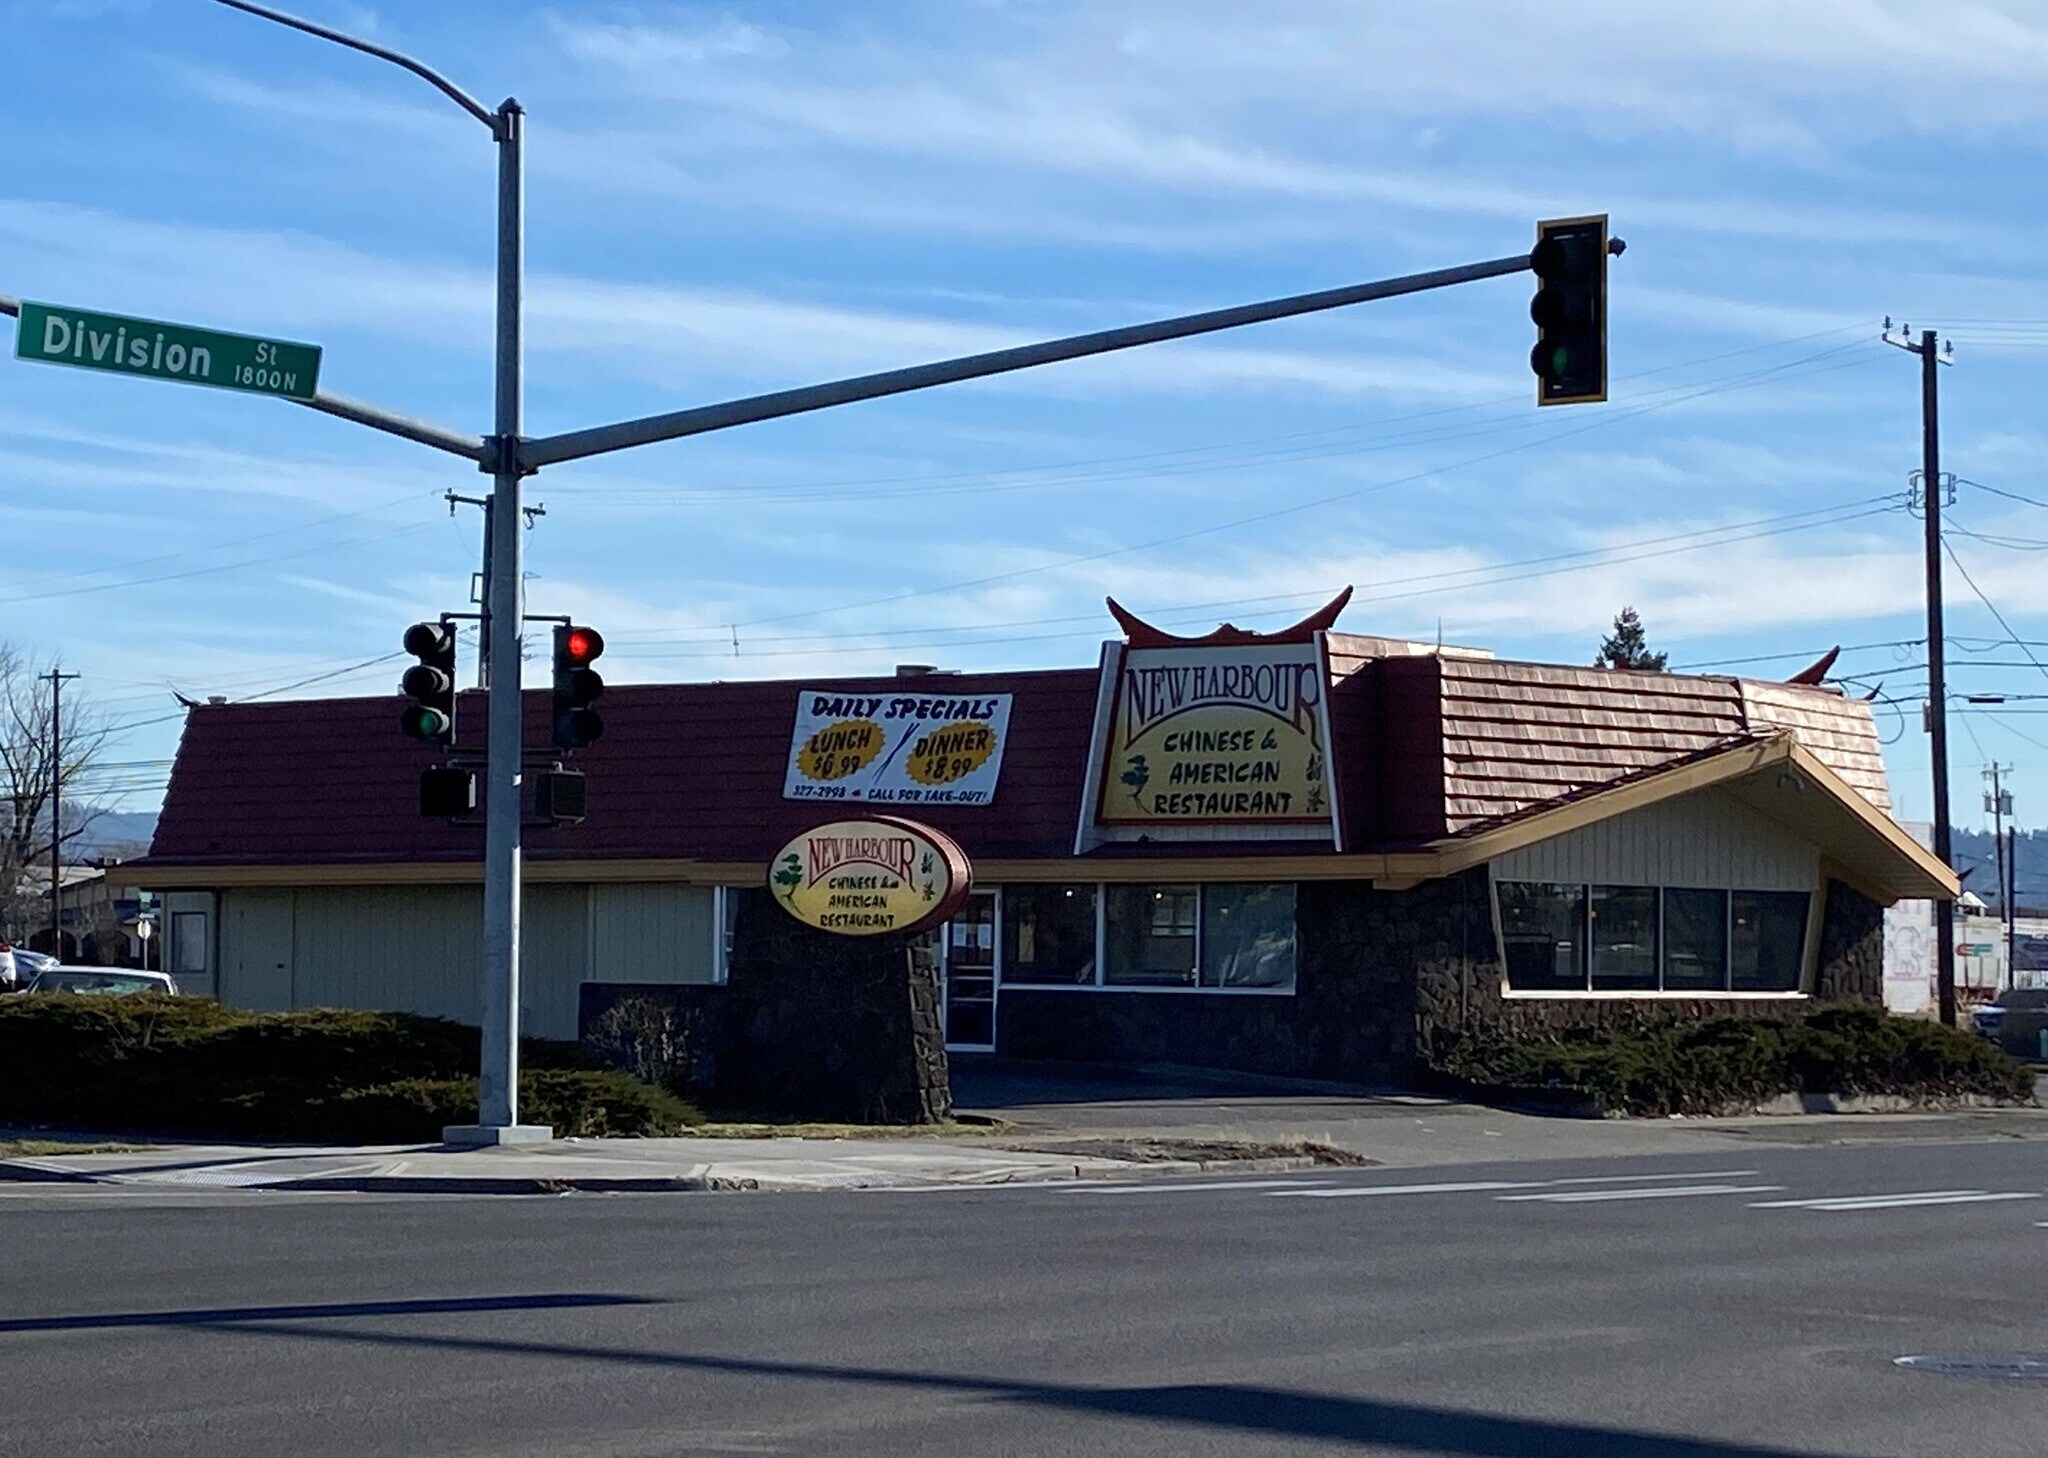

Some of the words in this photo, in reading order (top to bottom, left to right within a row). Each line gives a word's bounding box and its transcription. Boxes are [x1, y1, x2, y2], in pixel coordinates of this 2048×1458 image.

[43, 315, 211, 377] Division
[255, 342, 277, 366] St
[235, 365, 297, 391] 1800N
[811, 697, 883, 718] DAILY
[884, 698, 998, 720] SPECIALS
[1126, 665, 1190, 743] NEW
[1192, 663, 1322, 750] HARBOUR
[810, 727, 872, 754] LUNCH
[914, 728, 989, 759] DINNER
[1164, 729, 1256, 752] CHINESE
[1260, 728, 1278, 750] &
[813, 753, 861, 779] $6.99
[924, 757, 972, 783] $8.99
[1168, 760, 1281, 786] AMERICAN
[868, 788, 894, 801] CALL
[898, 789, 922, 801] FOR
[1154, 792, 1293, 816] RESTAURANT
[808, 836, 842, 884] NEW
[845, 837, 916, 891] HARBOUR
[828, 875, 877, 890] CHINESE
[828, 894, 888, 909] AMERICAN
[820, 913, 895, 927] RESTAURANT
